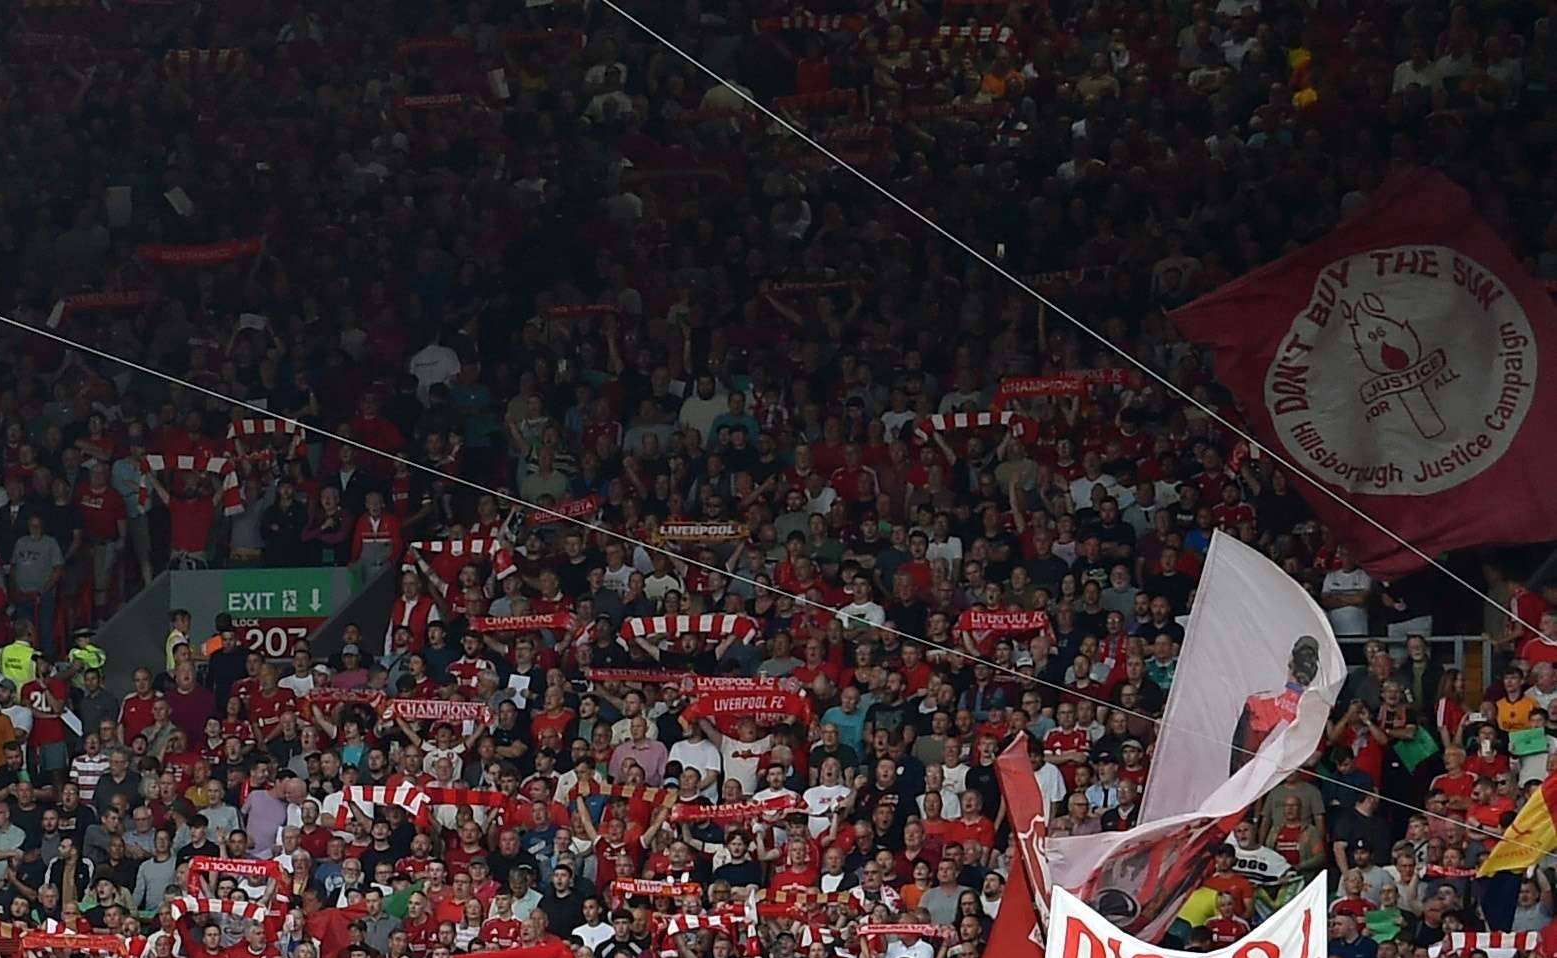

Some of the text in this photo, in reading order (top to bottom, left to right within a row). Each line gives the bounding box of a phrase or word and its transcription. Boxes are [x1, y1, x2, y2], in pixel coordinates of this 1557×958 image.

[1271, 250, 1504, 415] DON'T BUY THE SUN
[1368, 357, 1438, 397] JUSTICE
[1432, 369, 1460, 390] ALL
[1414, 434, 1492, 482] Justice
[1486, 322, 1530, 431] Campaign
[659, 524, 734, 537] LIVERPOOL
[228, 592, 275, 612] EXIT
[397, 701, 478, 717] CHAMPIONS
[714, 697, 767, 711] LIVERPOOL
